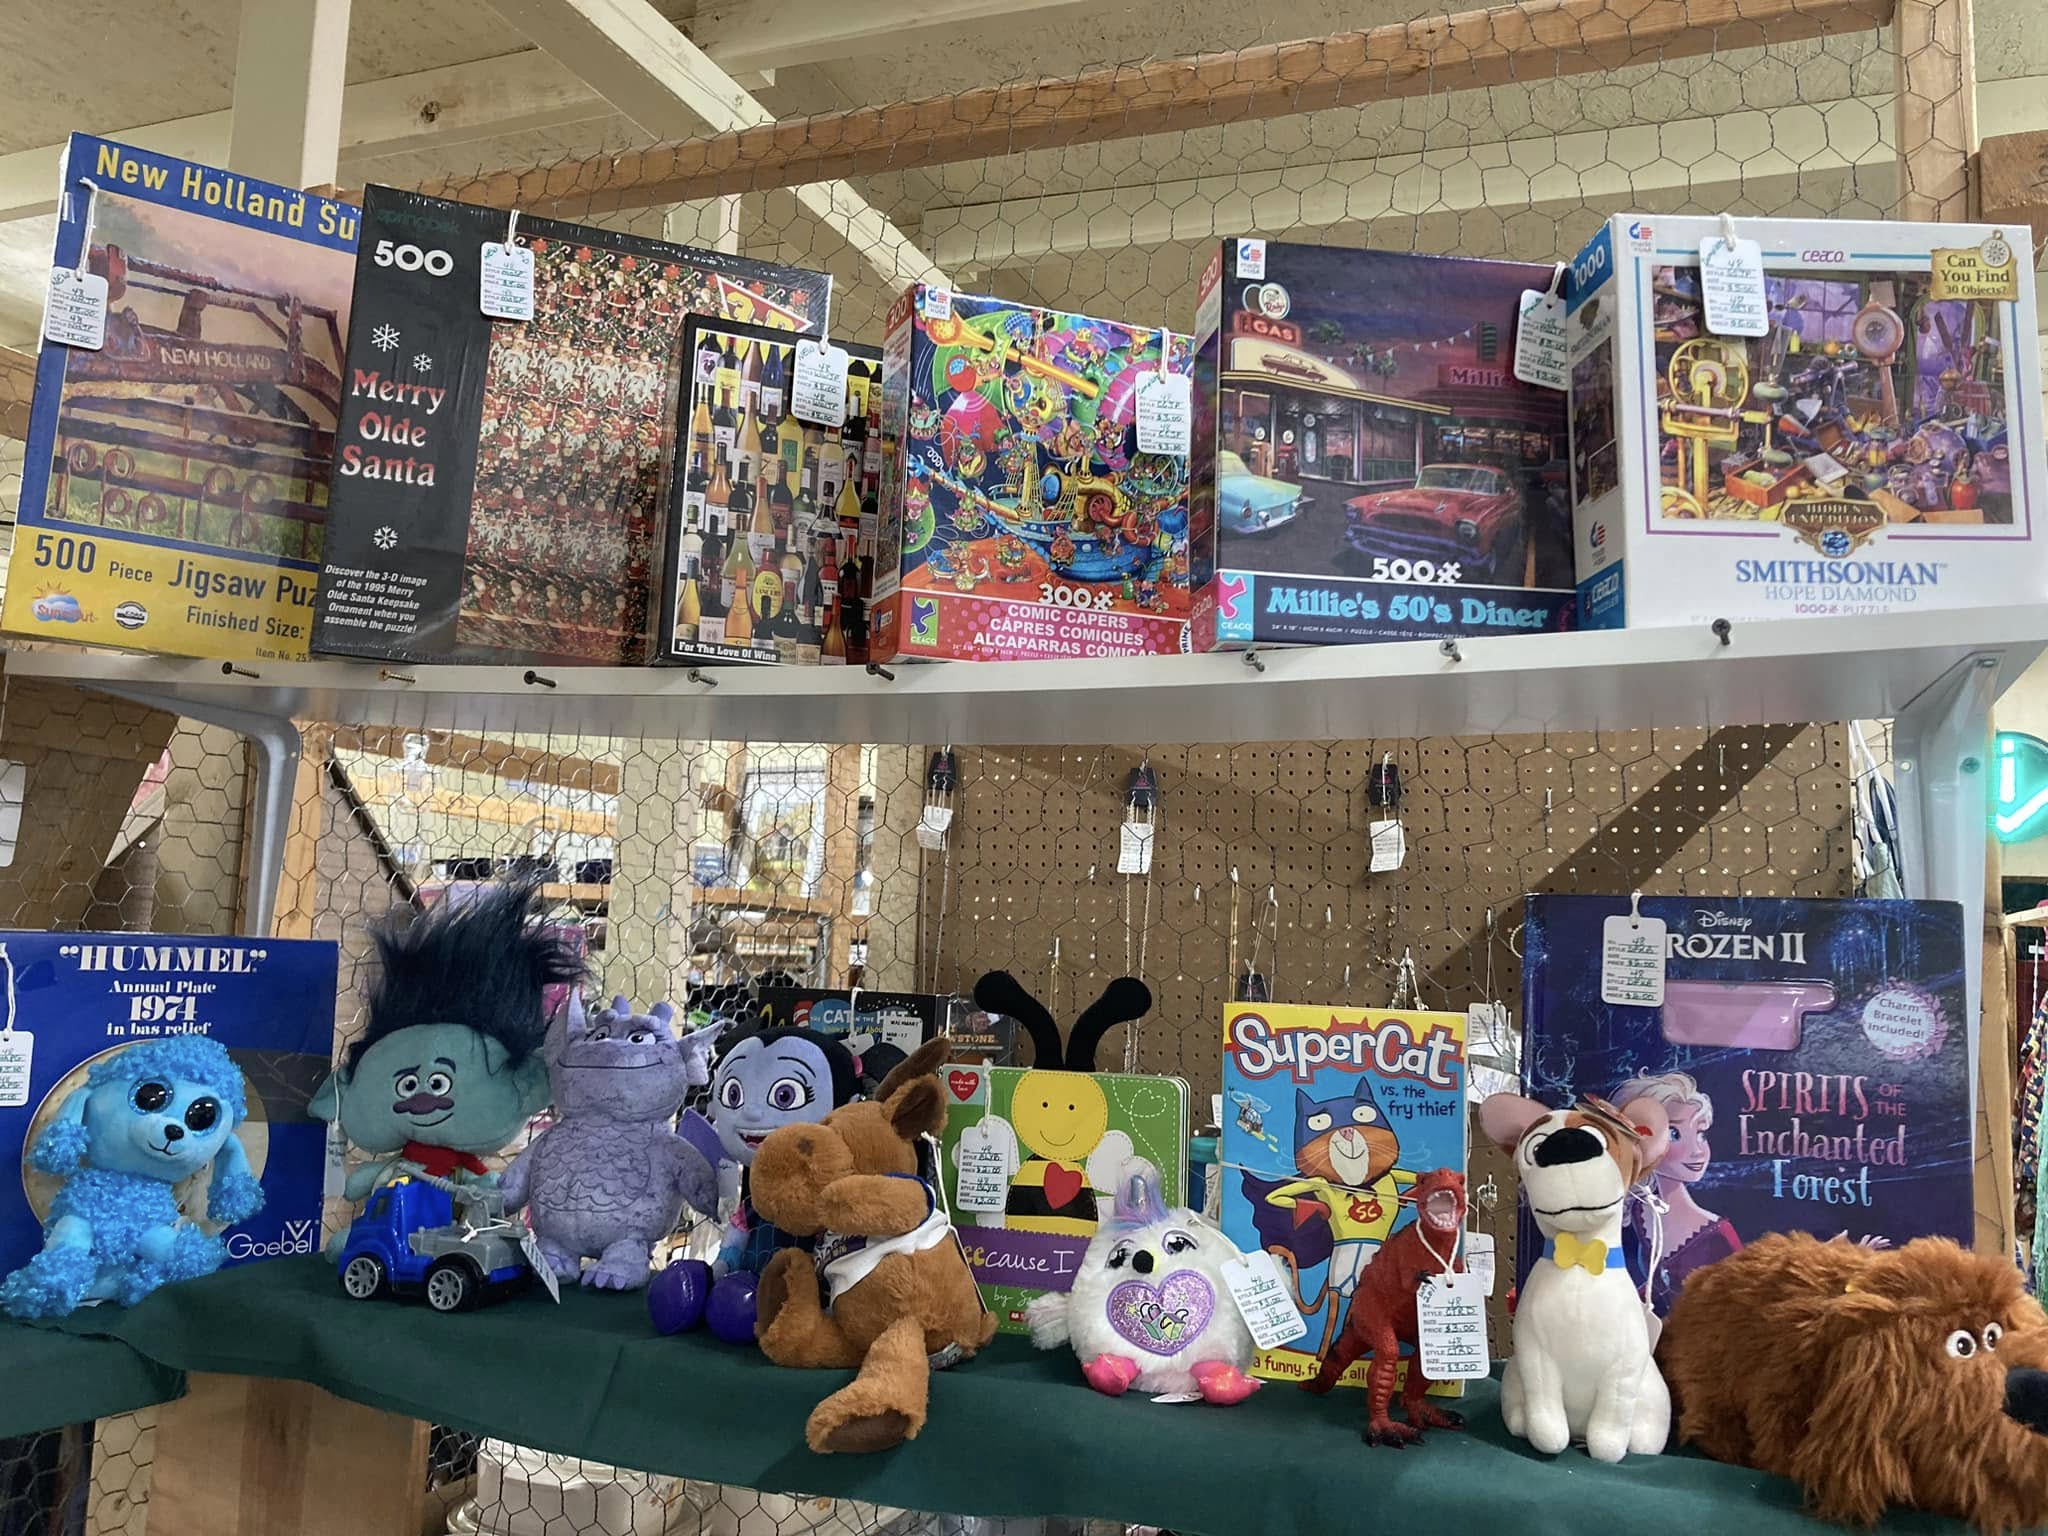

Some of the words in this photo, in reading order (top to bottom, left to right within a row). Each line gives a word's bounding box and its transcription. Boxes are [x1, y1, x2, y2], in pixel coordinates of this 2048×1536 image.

[96, 144, 168, 190] New
[181, 166, 306, 227] Holland
[318, 203, 356, 241] Su
[373, 240, 454, 277] 500
[1802, 249, 1845, 263] ceaco
[1947, 254, 1977, 268] Can
[1575, 245, 1605, 292] 1000
[1940, 269, 1971, 282] You
[1975, 269, 2010, 283] Find
[1945, 285, 1959, 294] 30
[1961, 285, 2007, 296] Objects?
[1253, 320, 1293, 340] GAS
[160, 347, 200, 366] NEW
[205, 350, 272, 371] HOLLAND
[352, 368, 446, 415] Merry
[359, 411, 427, 447] Olde
[340, 444, 435, 486] Santa
[34, 534, 97, 573] 500
[108, 561, 153, 583] Piece
[168, 558, 267, 600] Jigsaw
[325, 564, 365, 578] Discover
[365, 570, 380, 580] the
[381, 571, 398, 582] 3-D
[400, 574, 428, 587] image
[1372, 558, 1437, 583] 500
[1736, 560, 1939, 586] SMITHSONIAN
[336, 579, 347, 588] of
[347, 580, 362, 590] the
[364, 582, 386, 592] 1995
[387, 585, 414, 598] Merry
[1038, 582, 1092, 611] 300
[1765, 586, 1816, 601] HOPE
[1822, 586, 1918, 602] DIAMOND
[327, 590, 348, 601] Olde
[350, 592, 375, 604] Santa
[377, 596, 420, 610] Keepsake
[1267, 587, 1381, 620] Millie's
[1388, 595, 1453, 624] 50's
[1460, 598, 1548, 628] Diner
[1795, 603, 1827, 615] 1000
[1843, 605, 1890, 616] PUZZLE
[187, 605, 259, 633] Finished
[265, 617, 305, 640] Size:
[329, 602, 373, 616] Ornament
[374, 609, 397, 619] when
[399, 613, 416, 622] you
[1007, 604, 1061, 623] COMIC
[1066, 610, 1129, 630] CAPERS
[324, 615, 367, 628] assemble
[369, 619, 383, 630] the
[384, 623, 417, 634] puzzle!
[1221, 622, 1252, 630] CEACO
[973, 632, 1081, 657] ALCAPARRAS
[1060, 626, 1144, 647] COMIQUES
[255, 647, 276, 661] Item
[278, 650, 292, 661] No.
[679, 641, 694, 652] For
[696, 643, 714, 655] The
[717, 645, 739, 657] Love
[742, 647, 752, 658] Of
[754, 649, 777, 661] Wine
[1694, 909, 1752, 932] Disney
[1779, 933, 1807, 964] II
[108, 980, 170, 993] Annual
[176, 980, 217, 993] Plate
[129, 995, 198, 1022] 1974
[1880, 998, 1919, 1012] Charm
[823, 1010, 851, 1024] CAT
[1873, 1009, 1922, 1026] Bracelet
[106, 1022, 125, 1036] in
[130, 1022, 160, 1036] bas
[165, 1021, 212, 1036] relief
[1868, 1022, 1924, 1039] Included!
[1234, 1017, 1455, 1085] SuperCat
[1380, 1086, 1399, 1097] vs.
[1403, 1085, 1425, 1098] the
[1741, 1069, 1869, 1120] SPIRITS
[1879, 1083, 1904, 1097] OF
[1388, 1101, 1413, 1118] fry
[1417, 1101, 1456, 1116] thief
[1873, 1101, 1907, 1117] THE
[1738, 1114, 1908, 1166] Enchanted
[1772, 1159, 1872, 1207] Forest
[1355, 1205, 1378, 1219] SC
[226, 1228, 313, 1259] Goebel
[1053, 1250, 1075, 1274] I
[993, 1286, 1013, 1307] by
[1253, 1356, 1261, 1368] a
[1265, 1355, 1306, 1376] funny,
